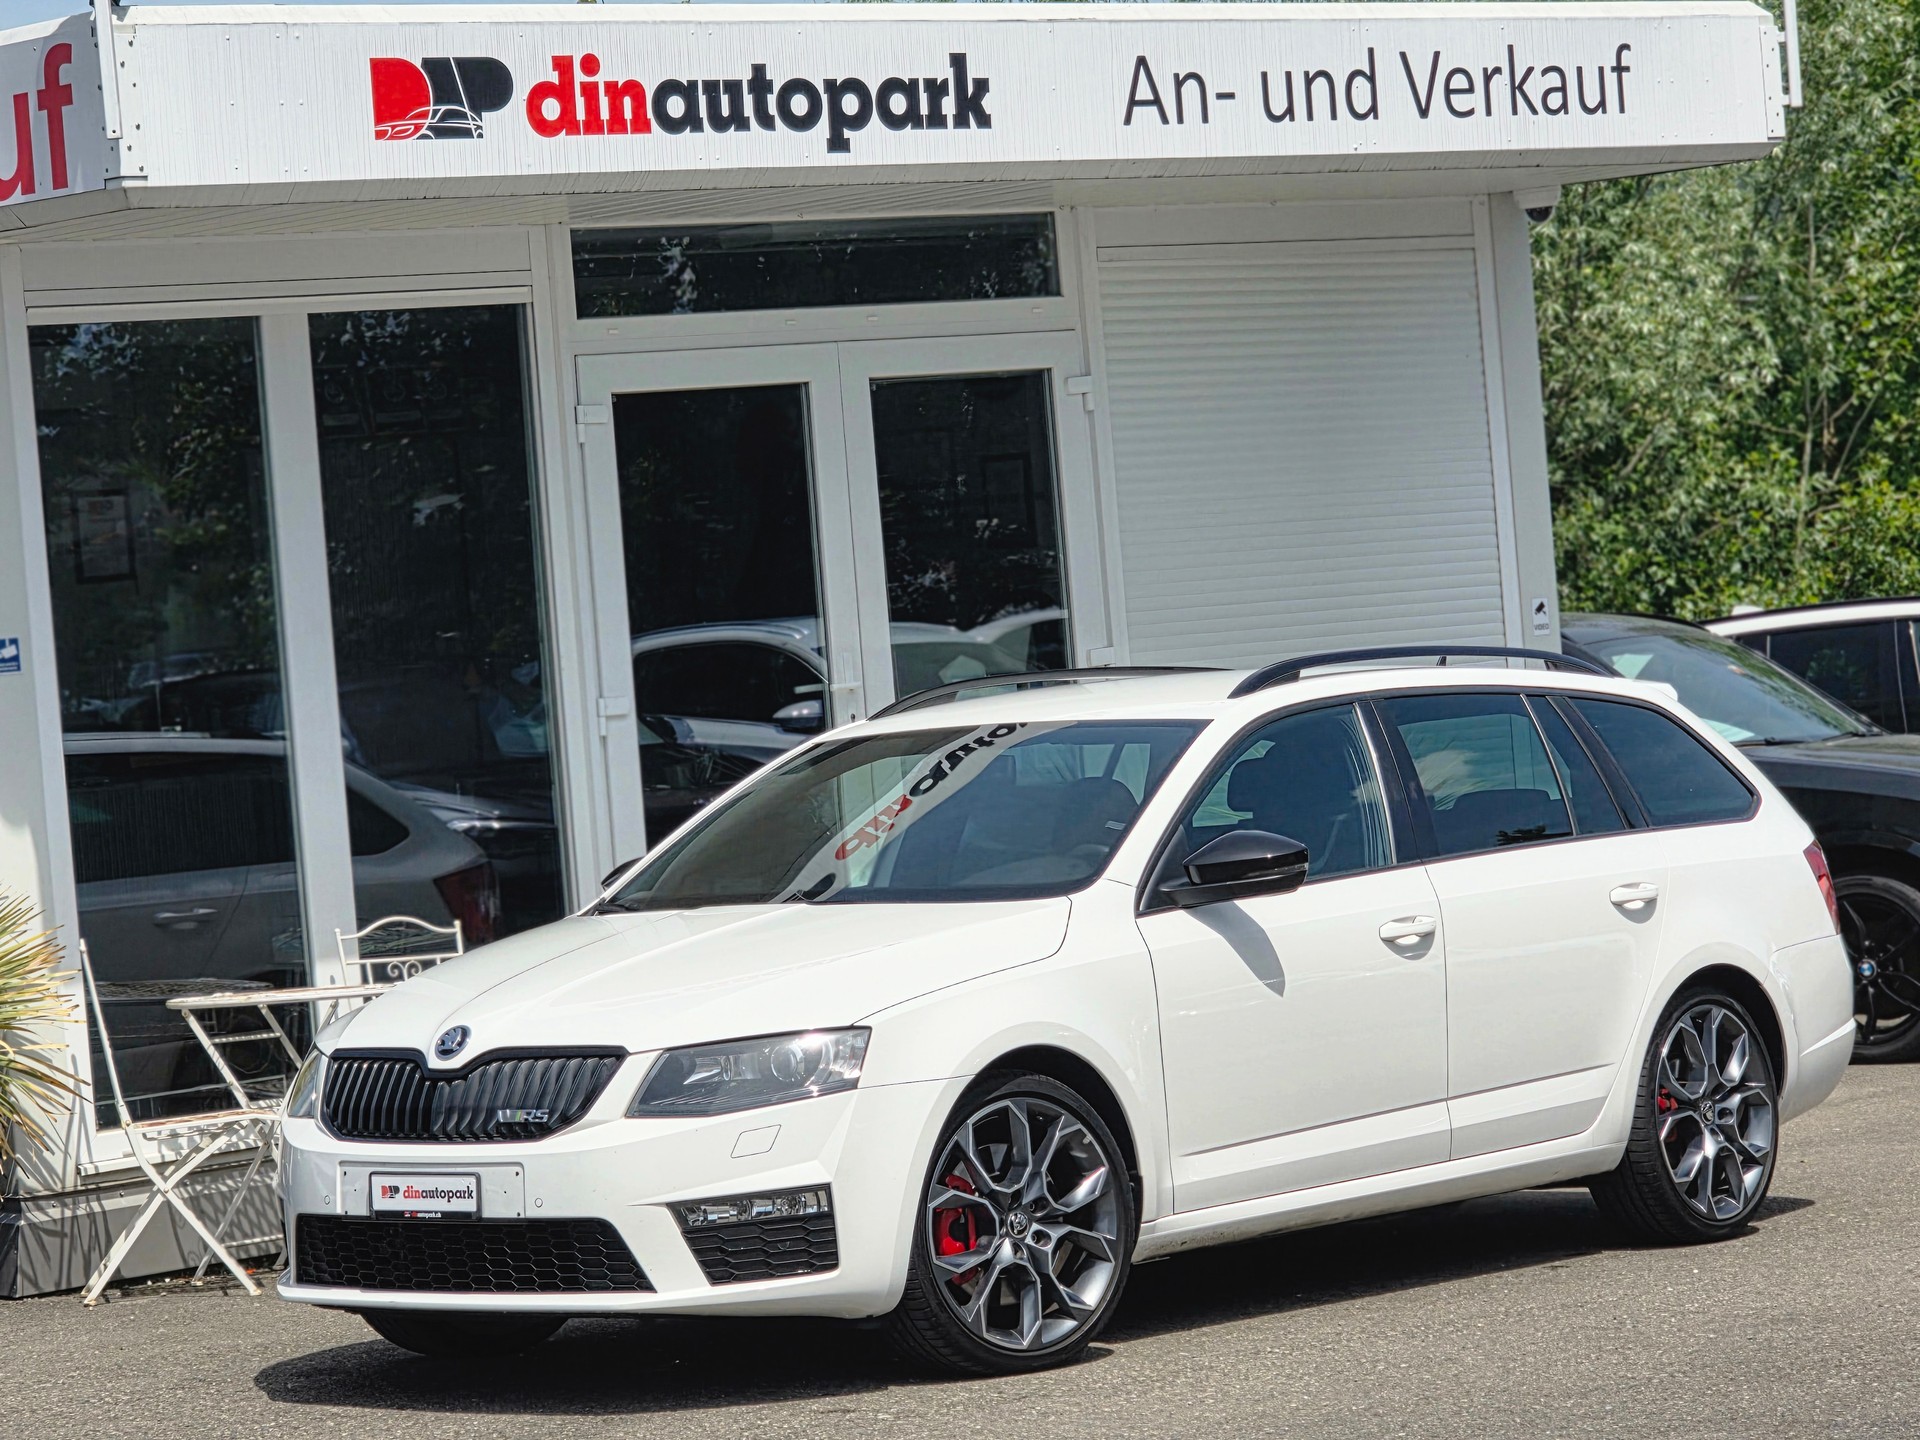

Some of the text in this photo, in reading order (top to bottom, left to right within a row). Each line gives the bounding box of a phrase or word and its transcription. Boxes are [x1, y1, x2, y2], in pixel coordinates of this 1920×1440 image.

[526, 53, 992, 153] dinautopark
[1124, 43, 1631, 125] An- und Verkauf
[403, 1186, 473, 1202] dinautopark
